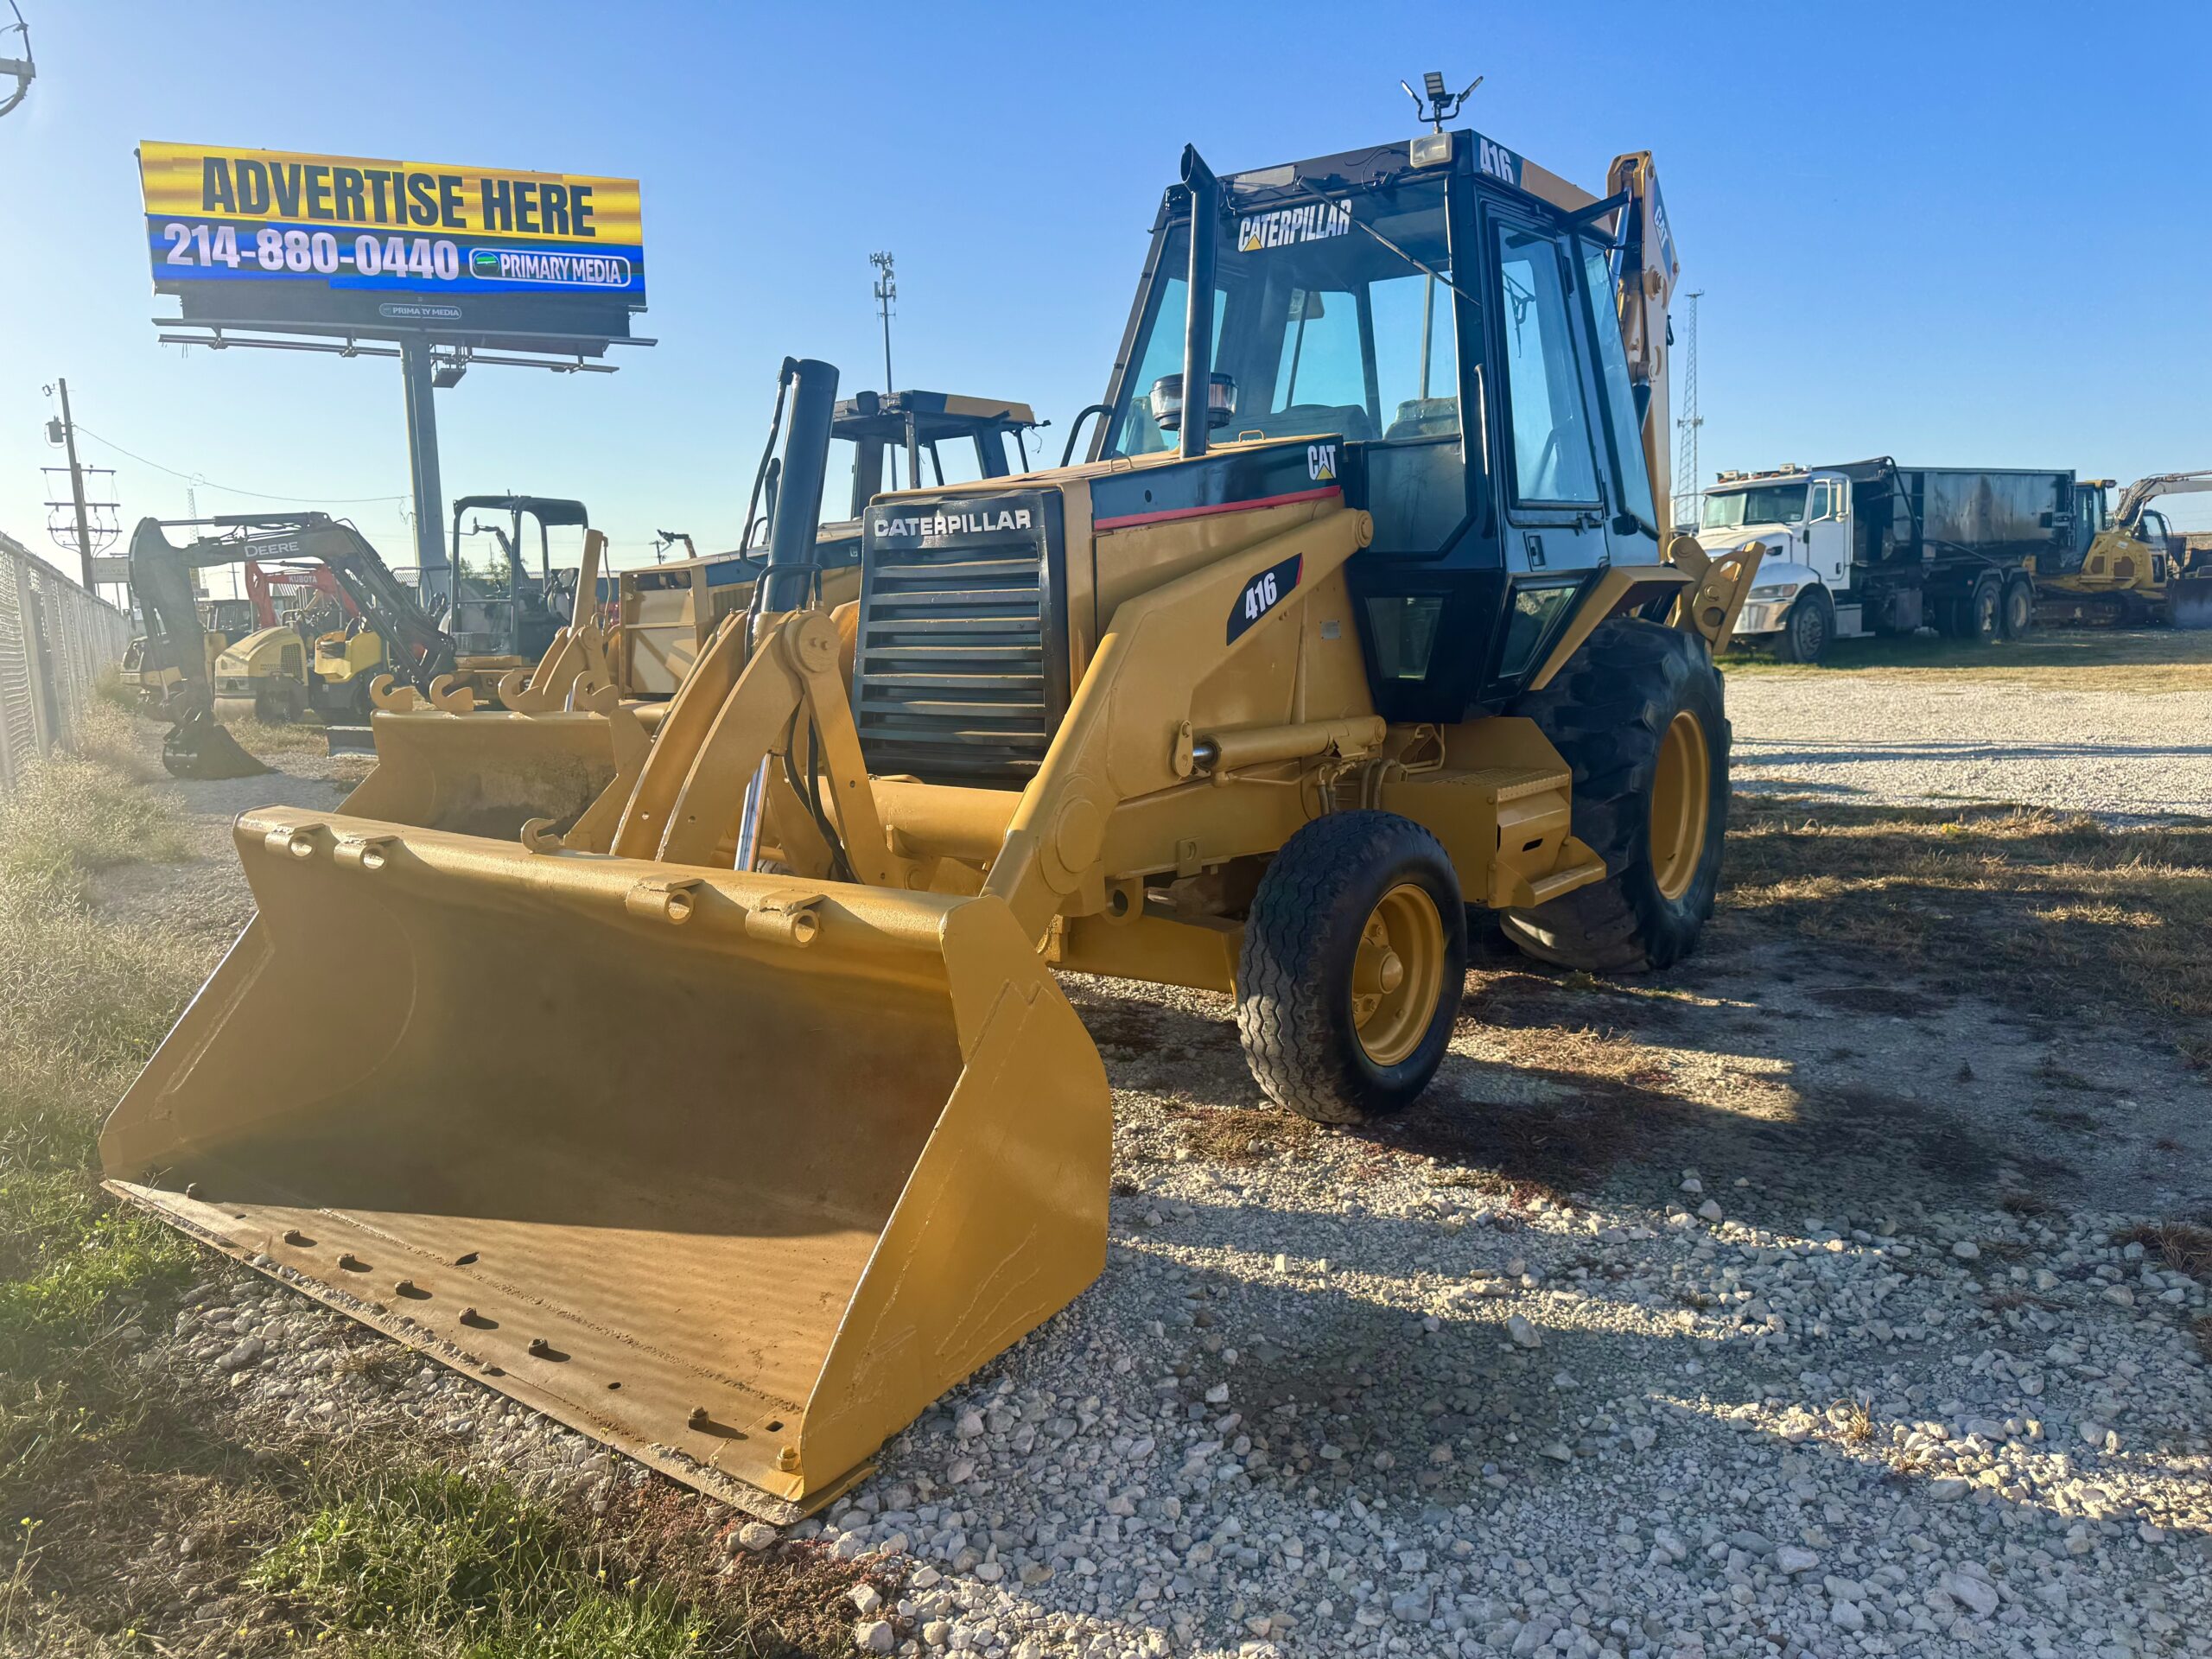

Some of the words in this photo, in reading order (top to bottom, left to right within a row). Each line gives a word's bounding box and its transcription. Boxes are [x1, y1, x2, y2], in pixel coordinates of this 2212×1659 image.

[1479, 137, 1514, 184] 416
[202, 156, 467, 228] ADVERTISE
[480, 178, 596, 237] HERE
[1237, 199, 1352, 252] CATERPILLAR
[1654, 205, 1669, 250] CAT
[163, 223, 460, 281] 214-880-0440
[499, 253, 569, 280] PRIMARY
[571, 257, 622, 283] MEDIA
[1307, 444, 1337, 480] CAT
[874, 509, 1032, 537] CATERPILLAR
[244, 541, 300, 557] DEERE
[289, 575, 318, 583] KUBOTA
[1245, 572, 1277, 620] 416
